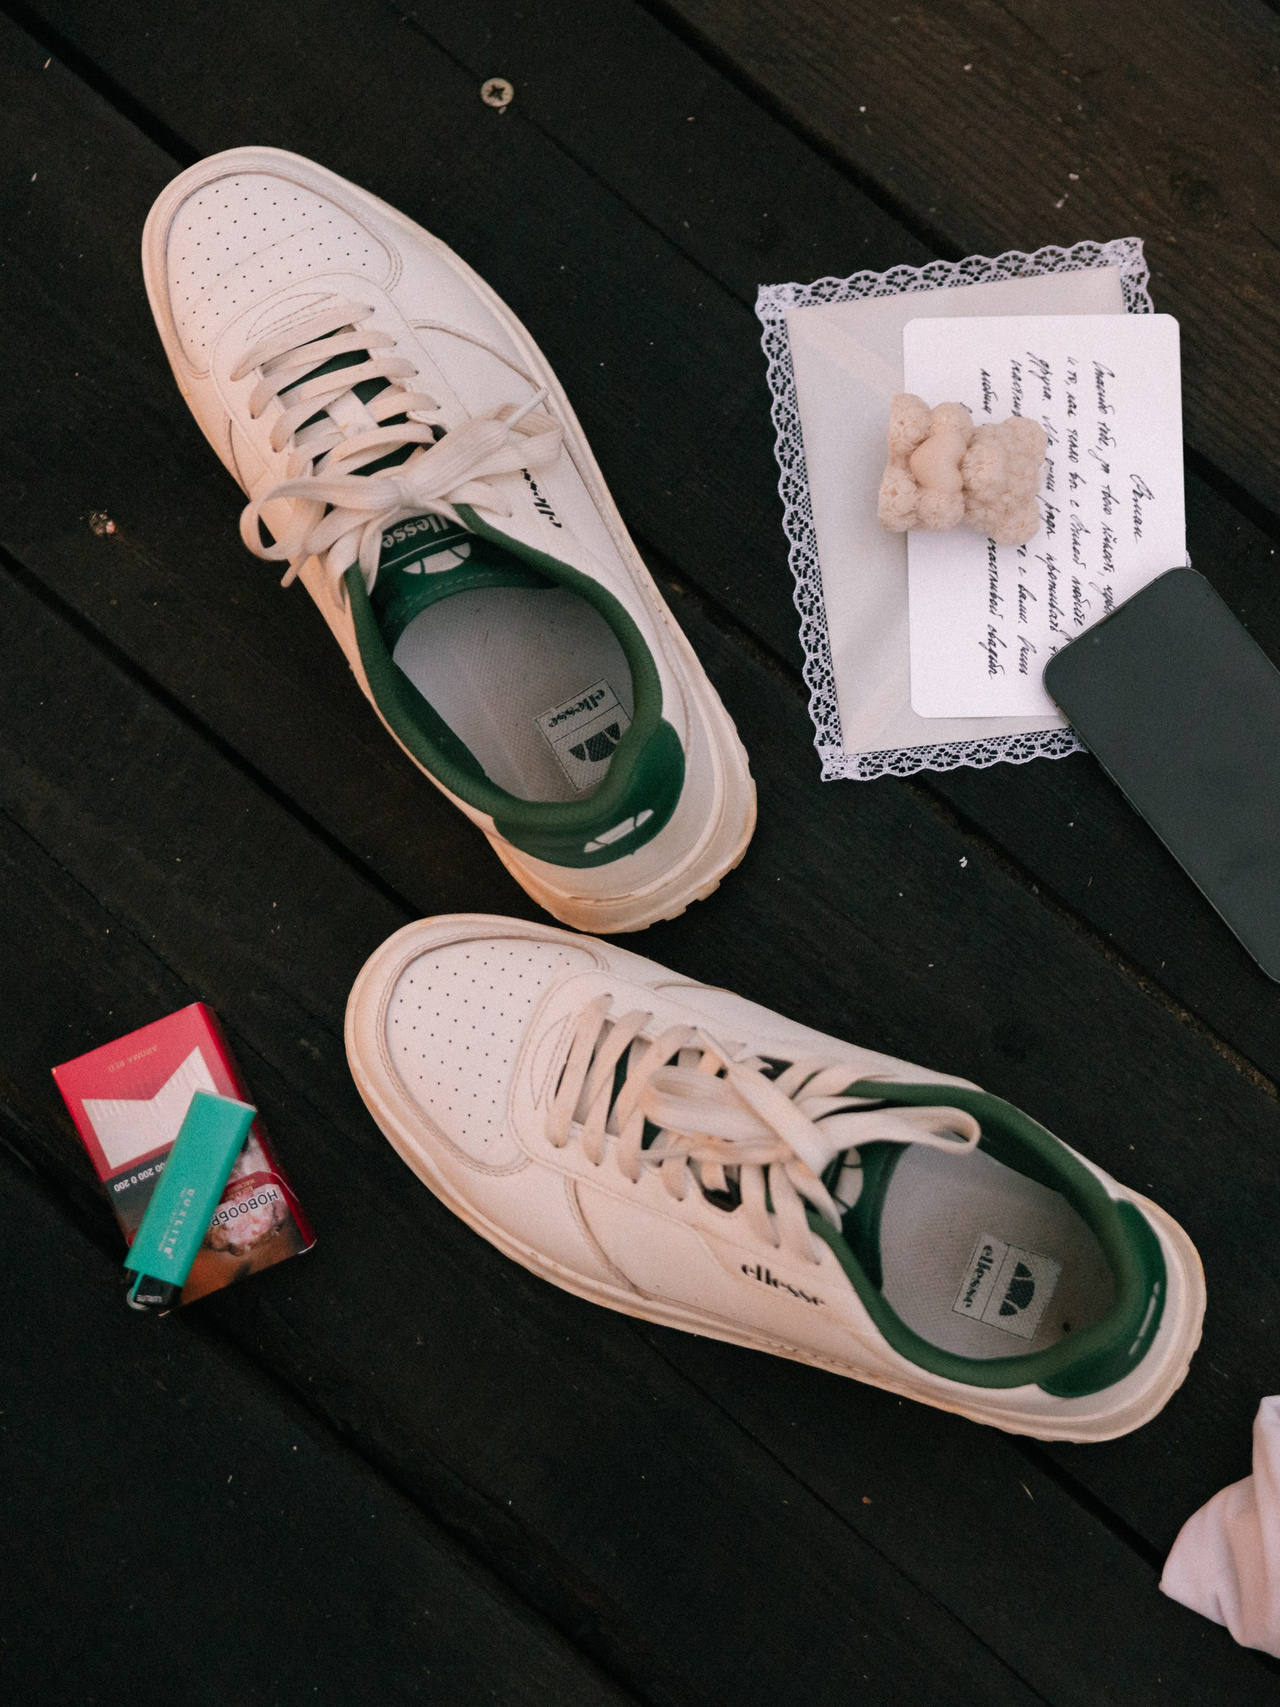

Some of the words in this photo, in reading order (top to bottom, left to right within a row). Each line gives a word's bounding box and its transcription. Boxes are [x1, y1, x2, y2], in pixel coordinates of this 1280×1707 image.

[979, 367, 998, 414] любим
[1025, 350, 1053, 401] друга.
[1091, 359, 1116, 415] Спасибо
[1065, 390, 1078, 417] как
[1065, 427, 1079, 463] тепло
[1086, 446, 1110, 474] за
[1067, 471, 1087, 491] вы
[1100, 483, 1120, 515] твою
[1035, 493, 1061, 540] рады
[1068, 498, 1080, 508] с
[1128, 472, 1155, 543] Роман
[379, 514, 450, 547] llesse
[1069, 513, 1091, 569] Викой
[986, 536, 1004, 620] счастливой
[1017, 565, 1027, 576] с
[1016, 582, 1037, 624] вами.
[1033, 551, 1065, 633] проживать
[1070, 574, 1091, 626] любите
[977, 623, 1008, 679] свадьбы
[1016, 634, 1037, 676] Очень
[547, 688, 605, 728] ellesse
[107, 1059, 125, 1072] RED
[126, 1044, 158, 1063] AROMA
[112, 1178, 130, 1192] 200
[129, 1175, 137, 1184] 0
[136, 1167, 155, 1181] 200
[208, 1190, 279, 1224] НОВООБР
[741, 1263, 825, 1307] ellesse
[962, 1244, 994, 1309] ellesse
